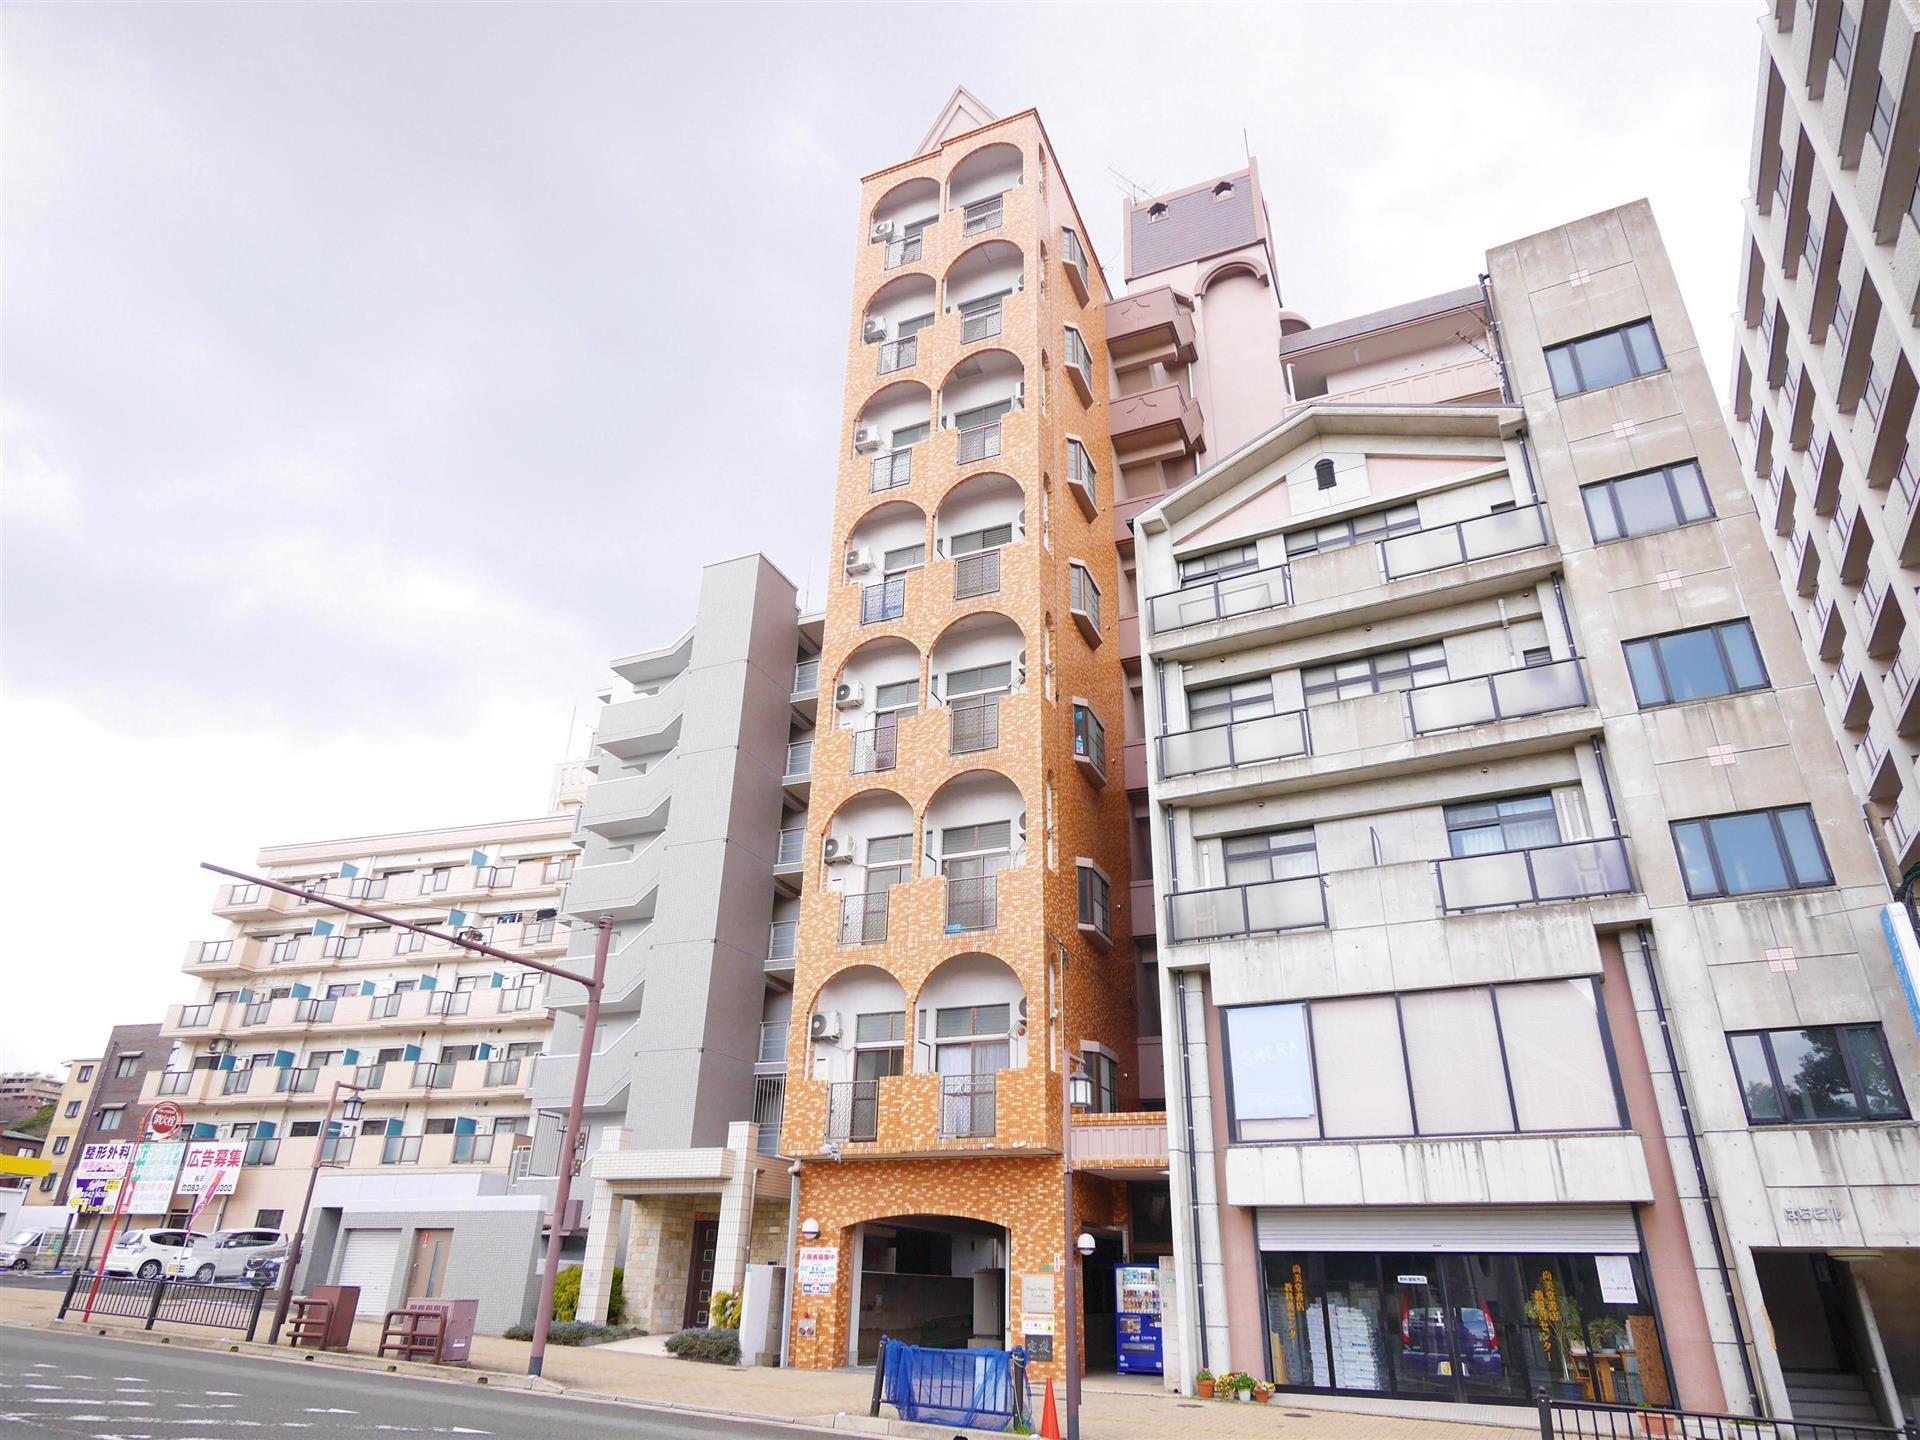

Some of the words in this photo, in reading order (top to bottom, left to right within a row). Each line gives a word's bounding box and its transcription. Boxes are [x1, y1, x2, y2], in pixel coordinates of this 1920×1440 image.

[152, 1113, 176, 1126] 消火栓
[84, 1145, 131, 1160] 整形外科
[187, 1148, 242, 1167] 広告募集
[1284, 1282, 1297, 1350] 教科書センター
[1535, 1290, 1551, 1362] 教科書センター
